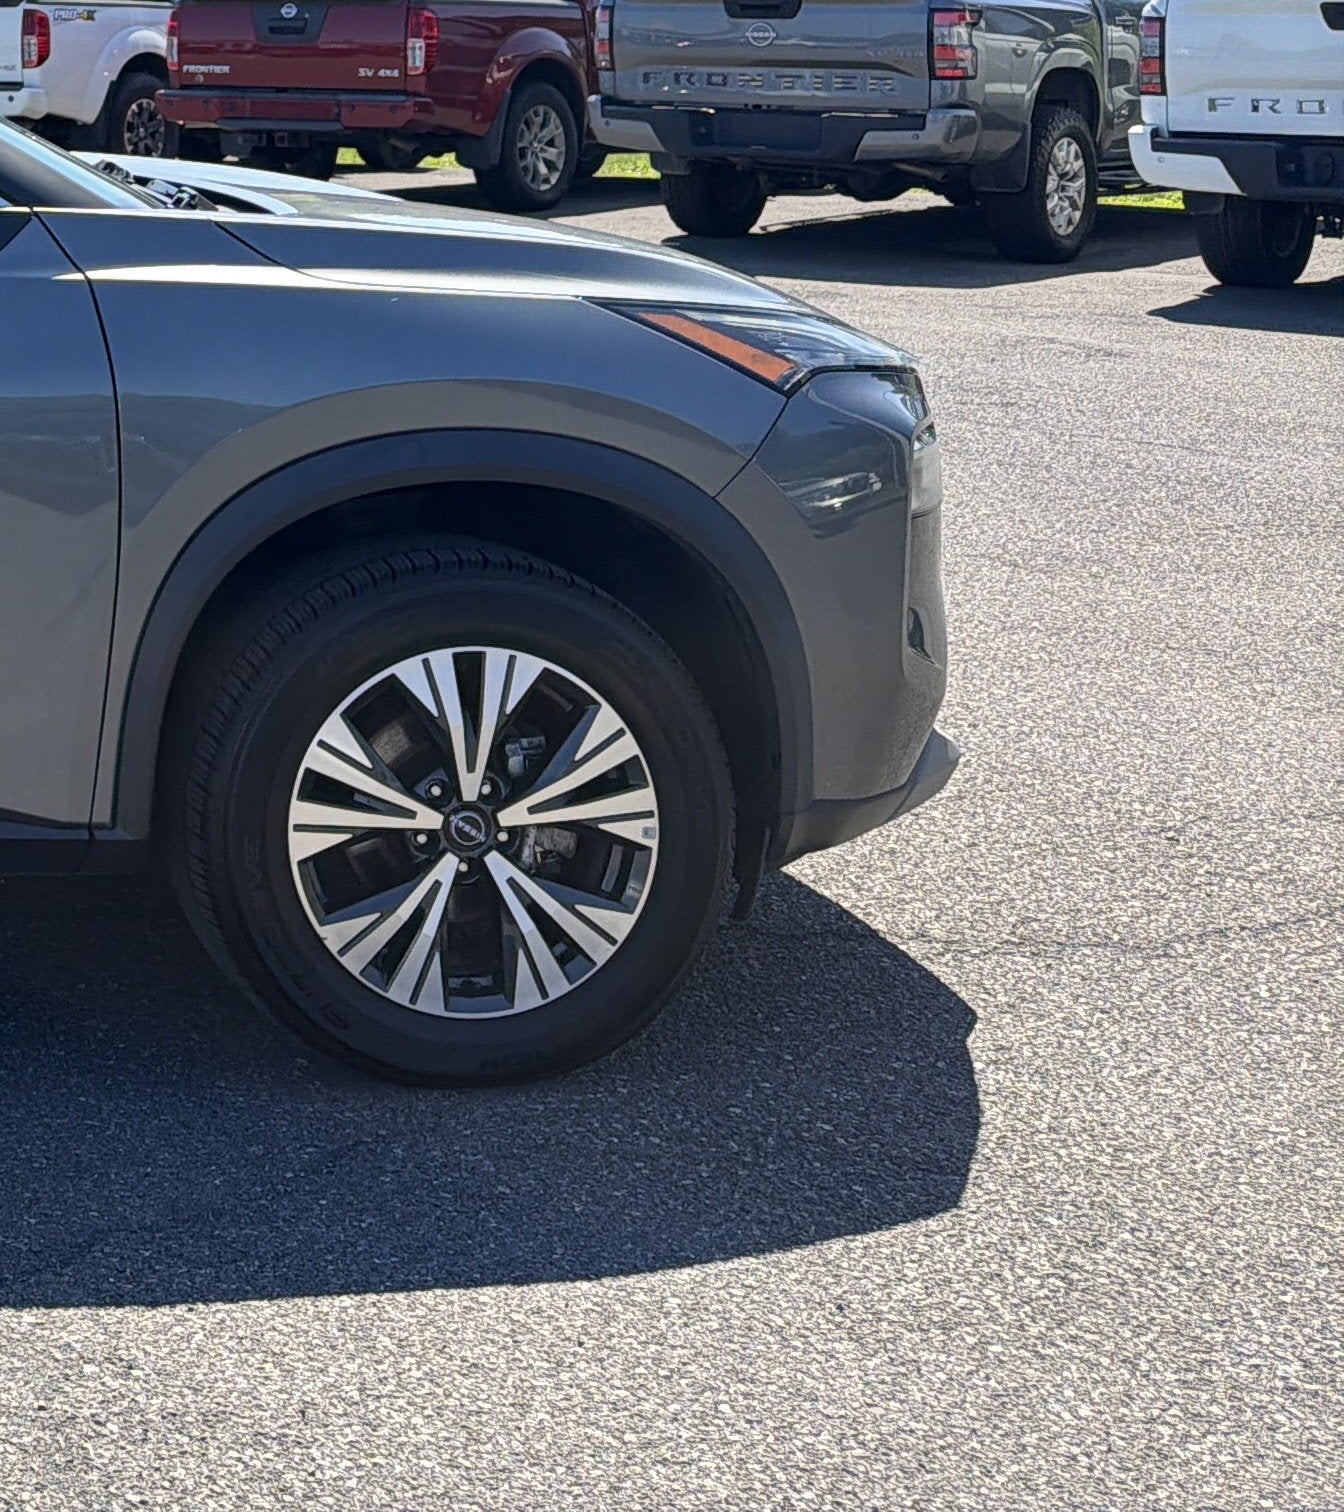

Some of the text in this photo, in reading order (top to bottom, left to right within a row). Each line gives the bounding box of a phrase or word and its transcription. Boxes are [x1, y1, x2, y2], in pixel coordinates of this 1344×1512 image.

[182, 64, 231, 74] FRONTIER
[357, 67, 375, 77] SV
[641, 71, 898, 92] FRONTIER
[1208, 96, 1344, 115] FRO
